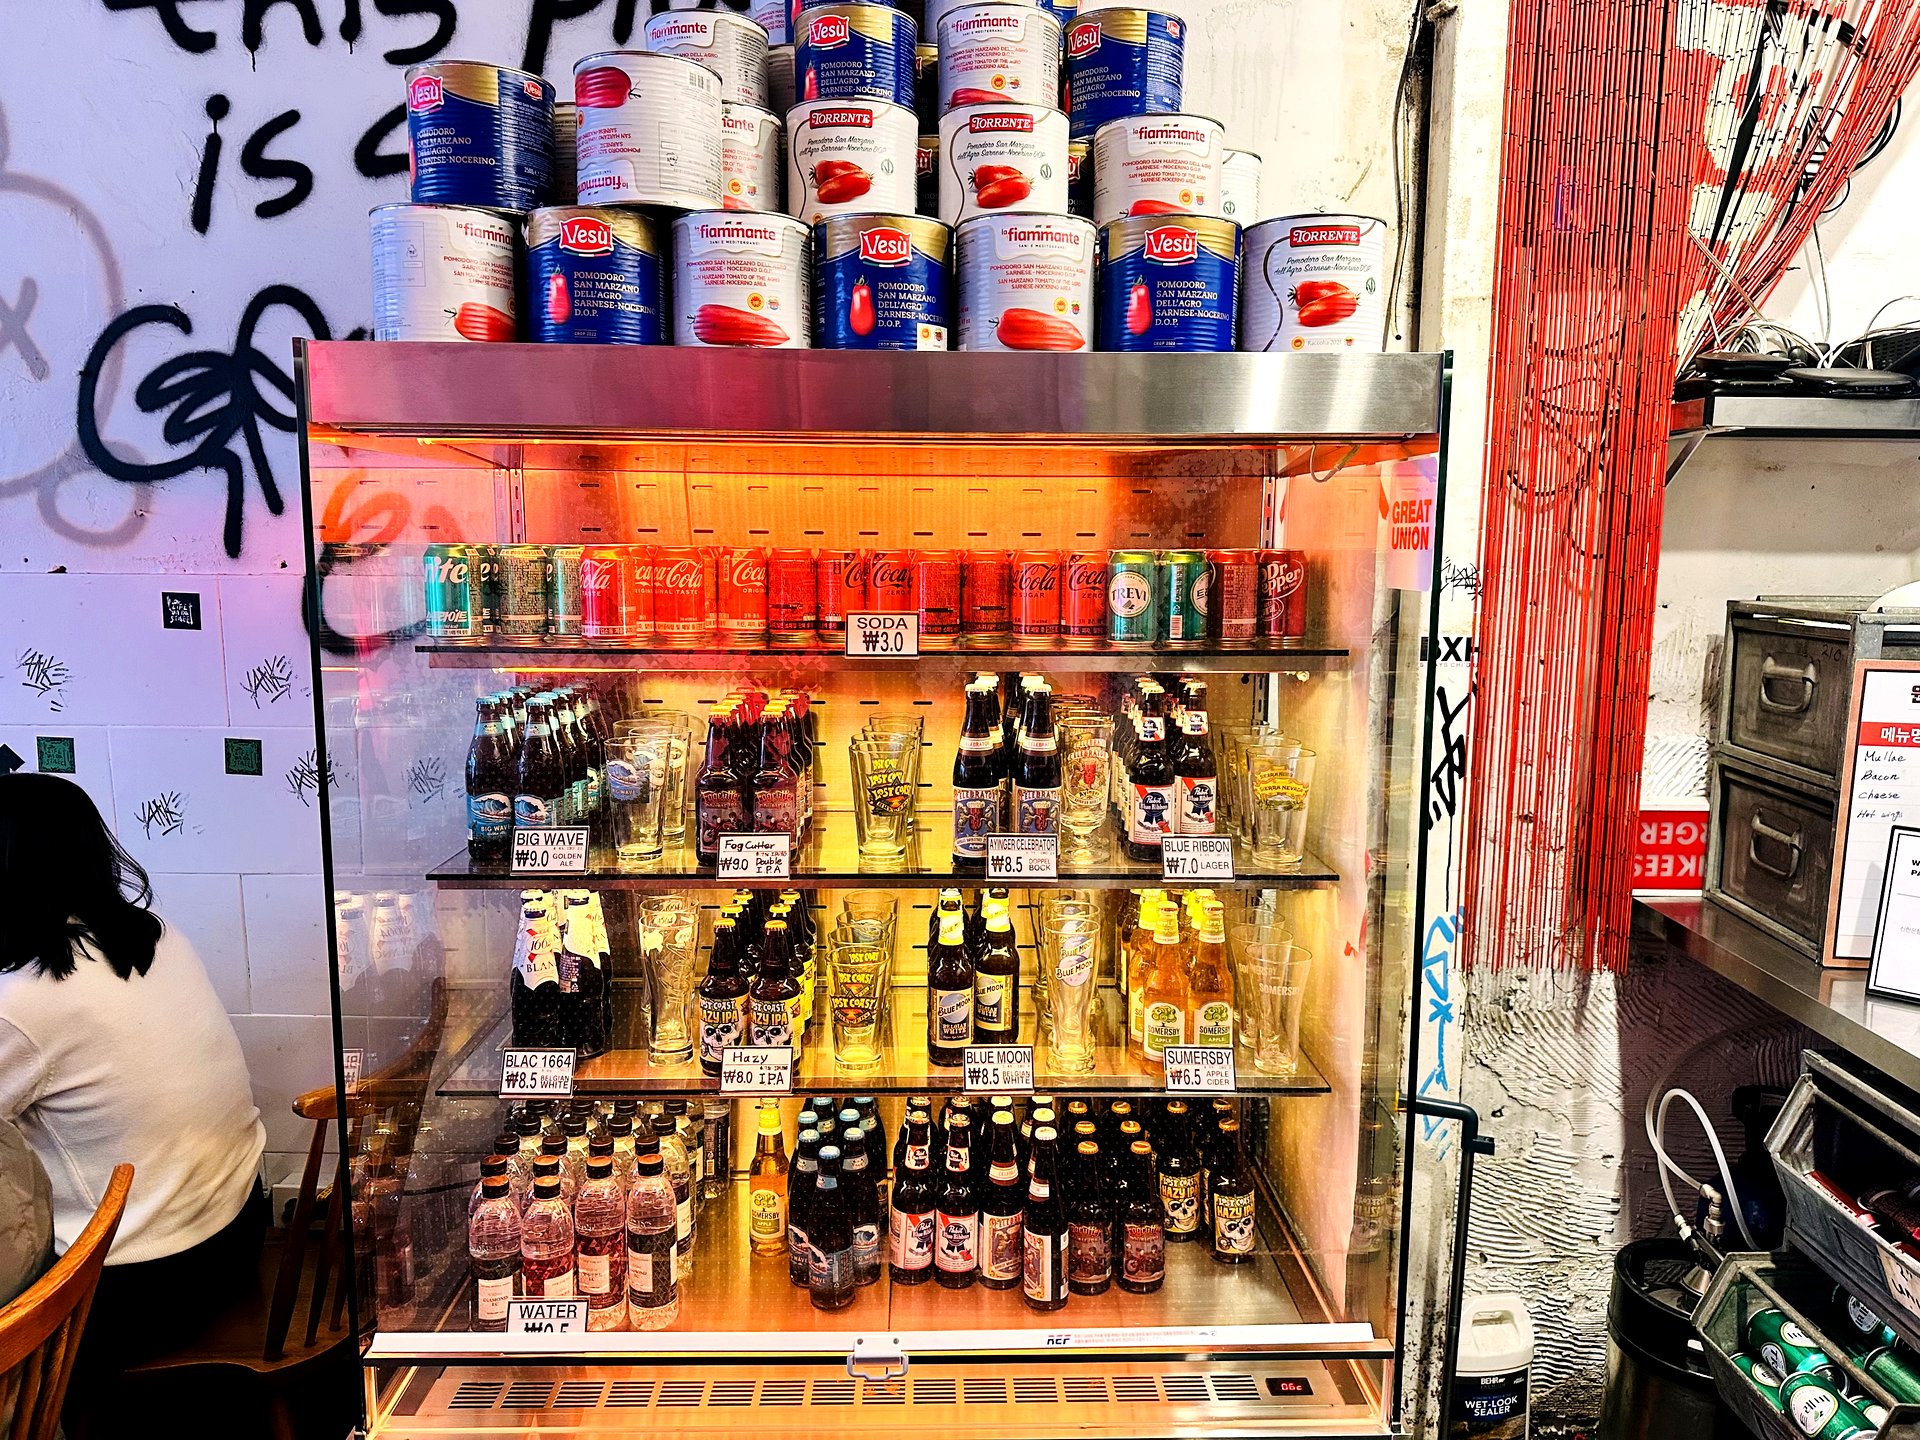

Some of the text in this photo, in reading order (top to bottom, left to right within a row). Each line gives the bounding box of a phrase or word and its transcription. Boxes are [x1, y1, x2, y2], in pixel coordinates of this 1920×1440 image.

[811, 20, 846, 41] Vesù
[955, 17, 1019, 33] fiammante
[1069, 27, 1098, 51] Vesù
[820, 61, 863, 70] POMODORO
[837, 70, 876, 78] MARZANO
[1073, 66, 1109, 80] POMODORO
[820, 78, 860, 86] DELL'AGRO
[1072, 74, 1122, 88] SAN MARZANO
[410, 82, 439, 106] Vesù
[1072, 84, 1106, 96] DELL'AGRO
[1138, 126, 1206, 143] fiammante
[190, 94, 314, 231] is
[1122, 159, 1151, 167] POMODORO
[562, 224, 609, 245] Vesù
[700, 224, 776, 241] fiammante
[1001, 227, 1080, 245] la fiammante
[1292, 229, 1358, 243] TORRENTE
[863, 234, 908, 255] Vesù
[1148, 233, 1193, 254] Vesù
[1286, 256, 1320, 265] Pomodoro
[1321, 254, 1334, 263] San
[990, 263, 1022, 271] POMODORO
[573, 271, 625, 282] POMODORO
[573, 281, 640, 294] SAN MARZANO
[877, 282, 926, 292] POMODORO
[1156, 280, 1206, 290] POMODORO
[574, 290, 622, 301] DELL'AGRO
[898, 292, 937, 304] MARZANO
[1156, 290, 1218, 301] SAN MARZANO
[574, 300, 656, 315] SARNESE-NOCERINO
[877, 301, 924, 311] DELL'AGRO
[1156, 299, 1202, 308] DELL'AGRO
[574, 308, 599, 317] D.O.P.
[1155, 308, 1230, 321] SARNESE-NOCERINO
[877, 320, 902, 328] D.O.P.
[1155, 318, 1179, 327] D.O.P.
[1392, 499, 1432, 525] GREAT
[1391, 526, 1430, 551] UNION
[1266, 563, 1288, 580] Dr
[1111, 587, 1147, 603] TREVI
[856, 617, 908, 630] SODA
[862, 630, 904, 652] ₩3.0
[516, 833, 584, 846] BIG WAVE
[724, 839, 776, 852] Fog Cutter
[989, 838, 1055, 851] AYINGER CELEBRATOR
[1164, 840, 1230, 853] BLUE RIBBON
[514, 849, 549, 867] ₩9.0
[552, 852, 583, 860] GOLDEN
[755, 857, 783, 866] Double
[990, 855, 1023, 872] ₩8.5
[1166, 856, 1199, 874] ₩7.0
[1200, 861, 1230, 870] LAGER
[1075, 960, 1094, 974] MOON
[986, 983, 1004, 993] MOON
[713, 1000, 736, 1010] COAST
[763, 1001, 785, 1011] COAST
[721, 1010, 739, 1024] IPA
[771, 1012, 789, 1025] IPA
[505, 1054, 572, 1068] BLAC 1664
[732, 1051, 769, 1065] Hazy
[966, 1050, 1031, 1064] BLUE MOON
[1167, 1050, 1231, 1065] SUMERSBY
[504, 1070, 538, 1089] ₩8.5
[540, 1074, 570, 1082] BELGIAN
[723, 1069, 753, 1085] ₩8.0
[967, 1067, 1000, 1085] ₩8.5
[1169, 1067, 1202, 1085] ₩6.5
[1205, 1070, 1230, 1078] APPLE
[540, 1080, 569, 1089] WHITE
[1002, 1077, 1031, 1085] WHITE
[1206, 1078, 1230, 1086] CIDER
[1161, 1187, 1185, 1198] HAZY
[1217, 1205, 1242, 1218] HAZY
[519, 1304, 578, 1319] WATER
[1480, 1376, 1500, 1385] BEHR
[1464, 1395, 1518, 1409] WET-LOOK
[1473, 1405, 1511, 1417] SEALER
